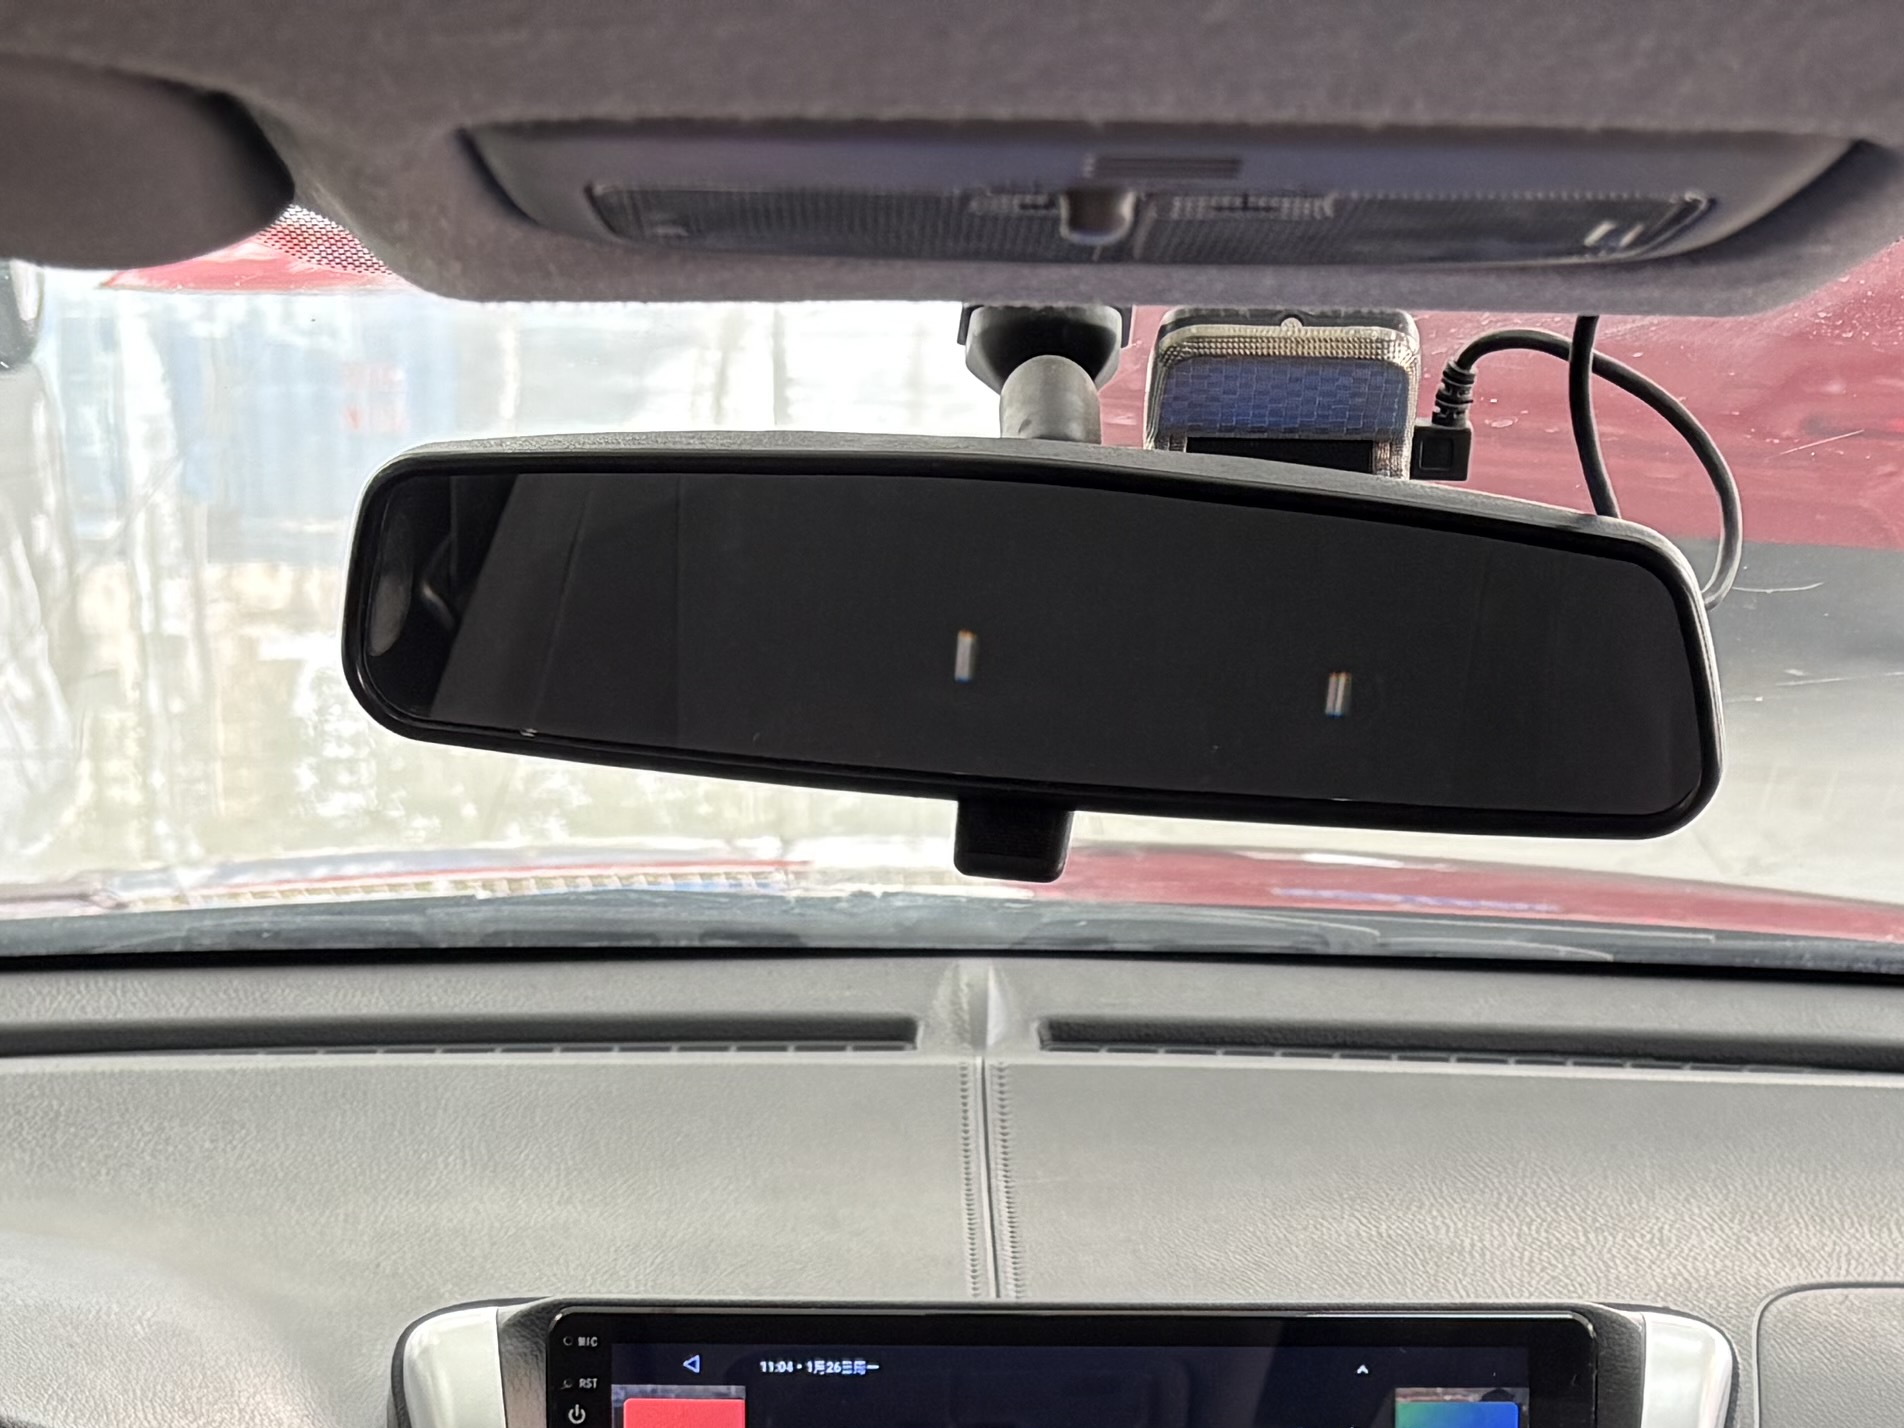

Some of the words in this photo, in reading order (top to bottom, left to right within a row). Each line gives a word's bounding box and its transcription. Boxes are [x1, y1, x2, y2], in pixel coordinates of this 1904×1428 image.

[577, 1336, 598, 1347] MIC
[760, 1360, 794, 1373] 11:04
[579, 1378, 598, 1389] RST
